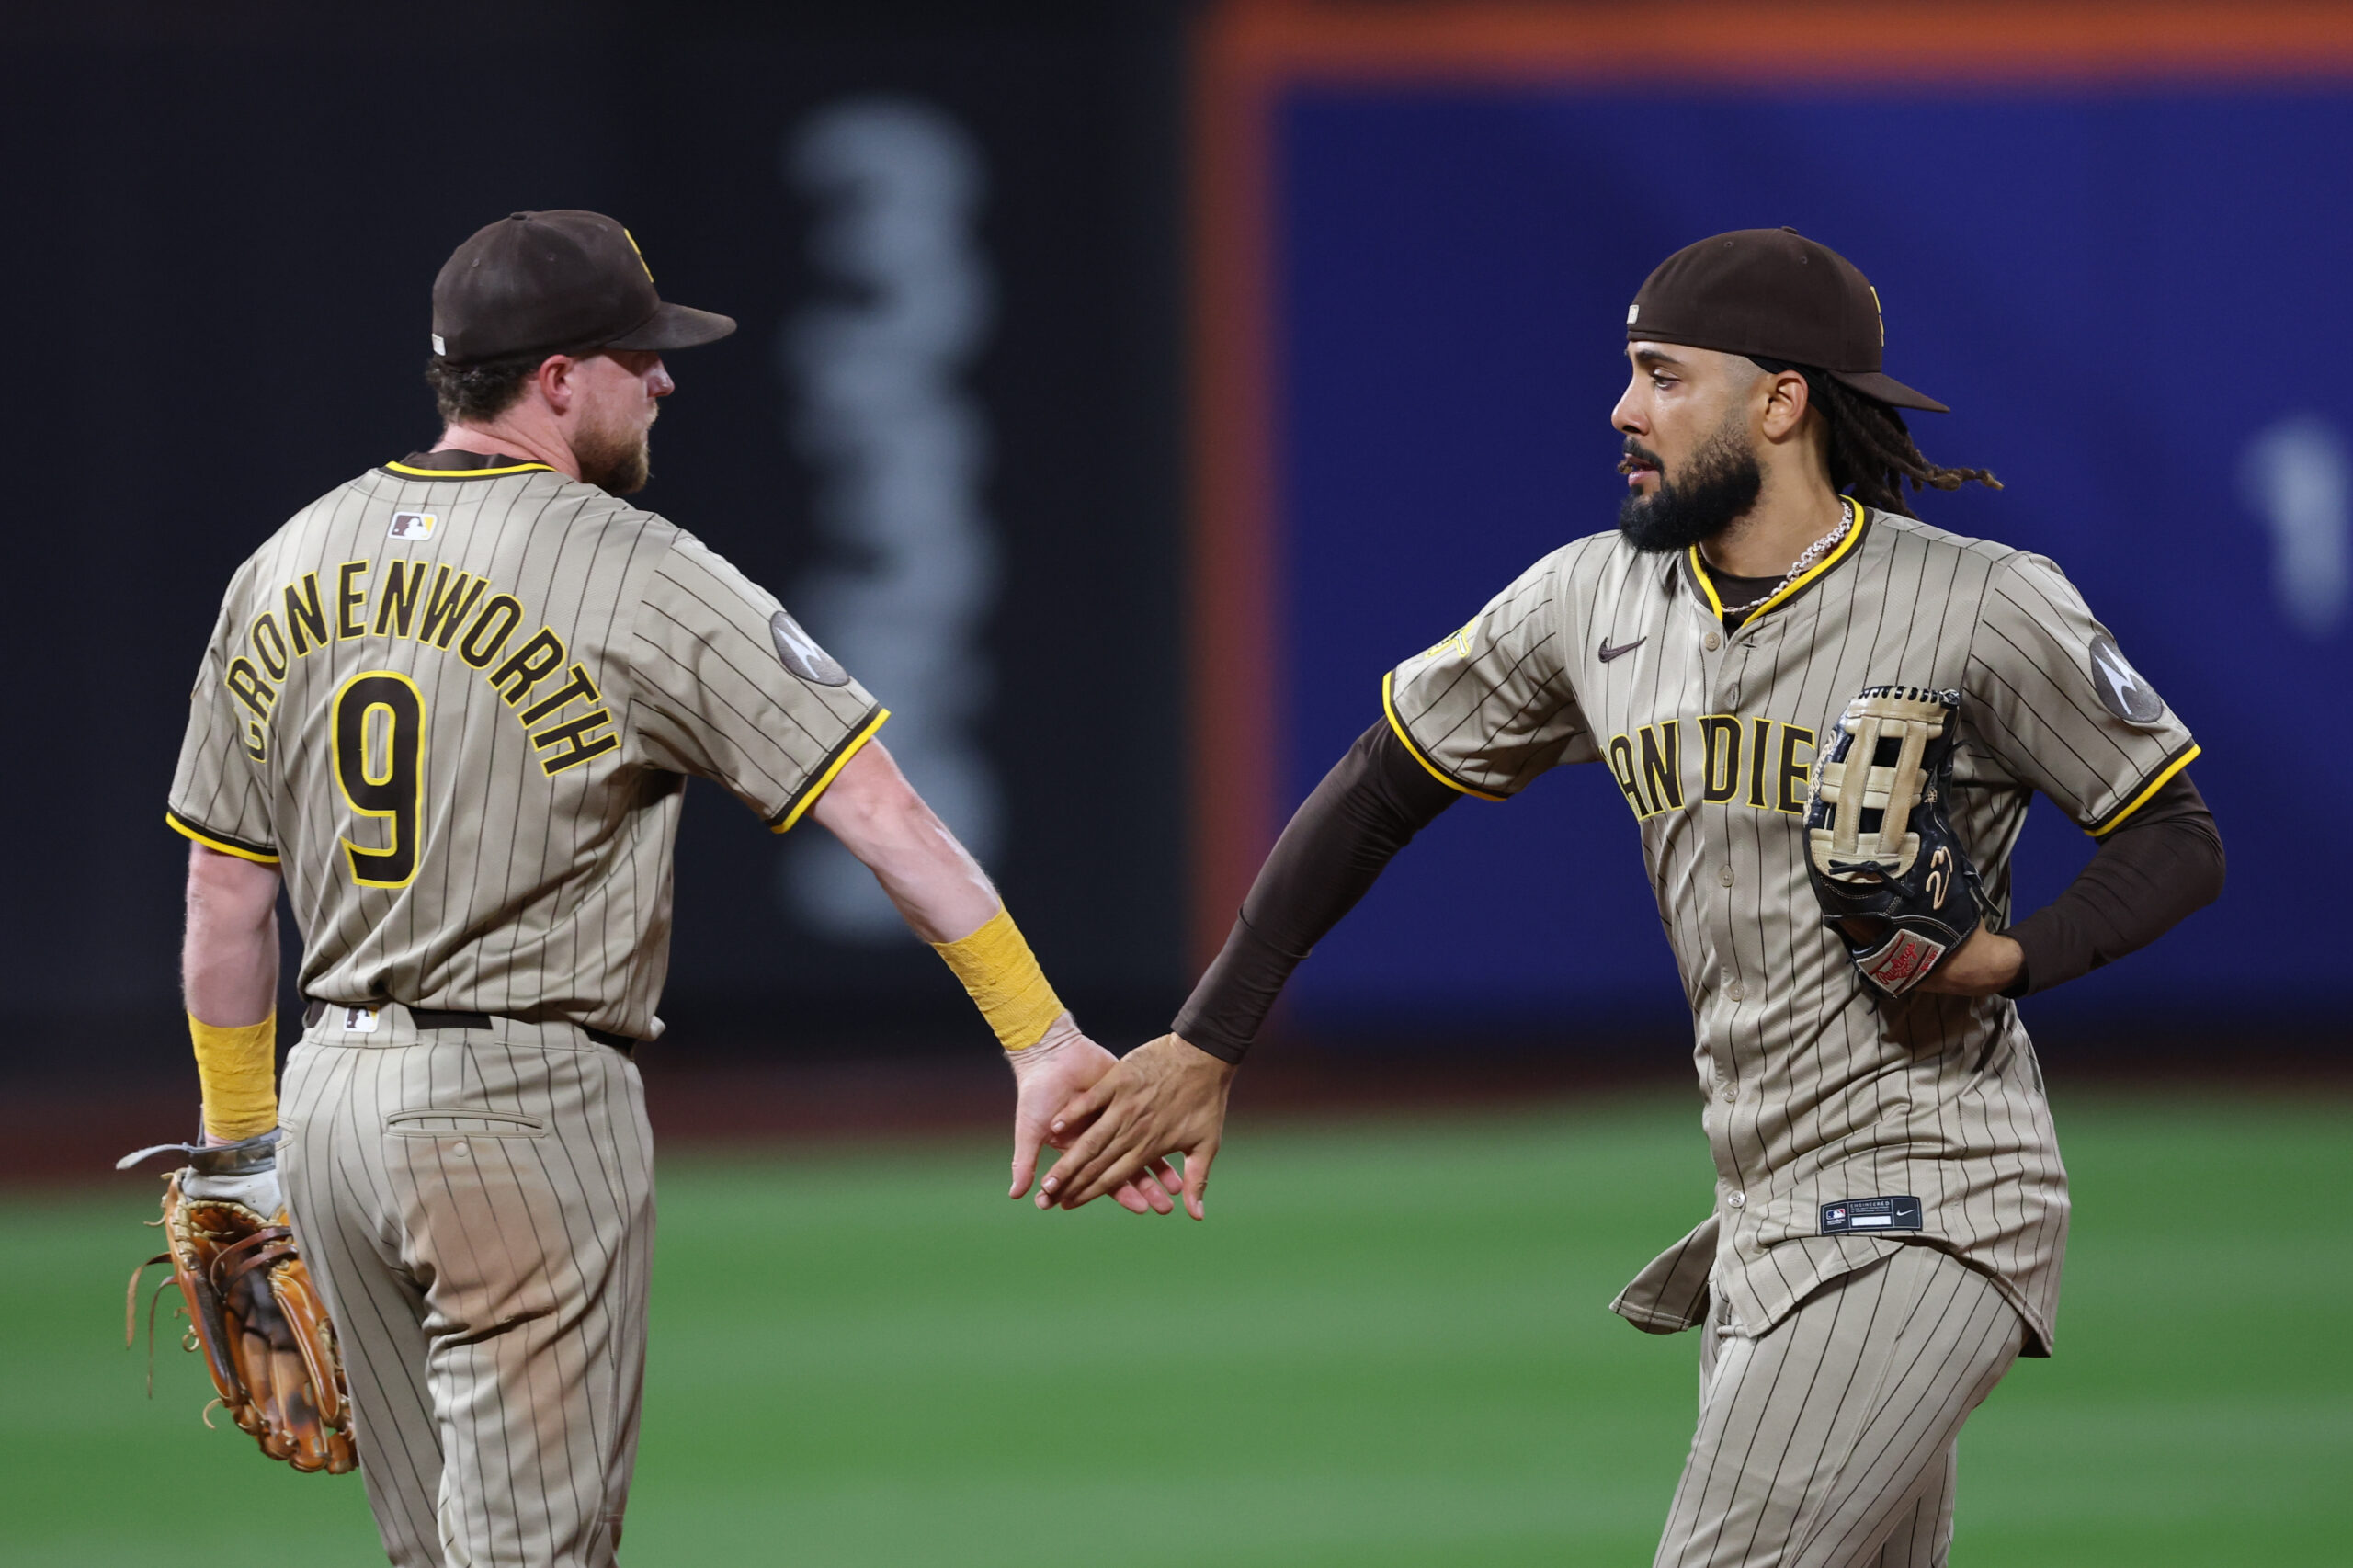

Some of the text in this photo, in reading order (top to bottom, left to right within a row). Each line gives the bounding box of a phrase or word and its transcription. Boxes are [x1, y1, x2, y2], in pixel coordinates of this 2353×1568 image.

[225, 558, 622, 777] CRONENWORTH
[1599, 718, 1686, 822] AN
[1696, 714, 1816, 816] DIE
[331, 669, 426, 890] 9
